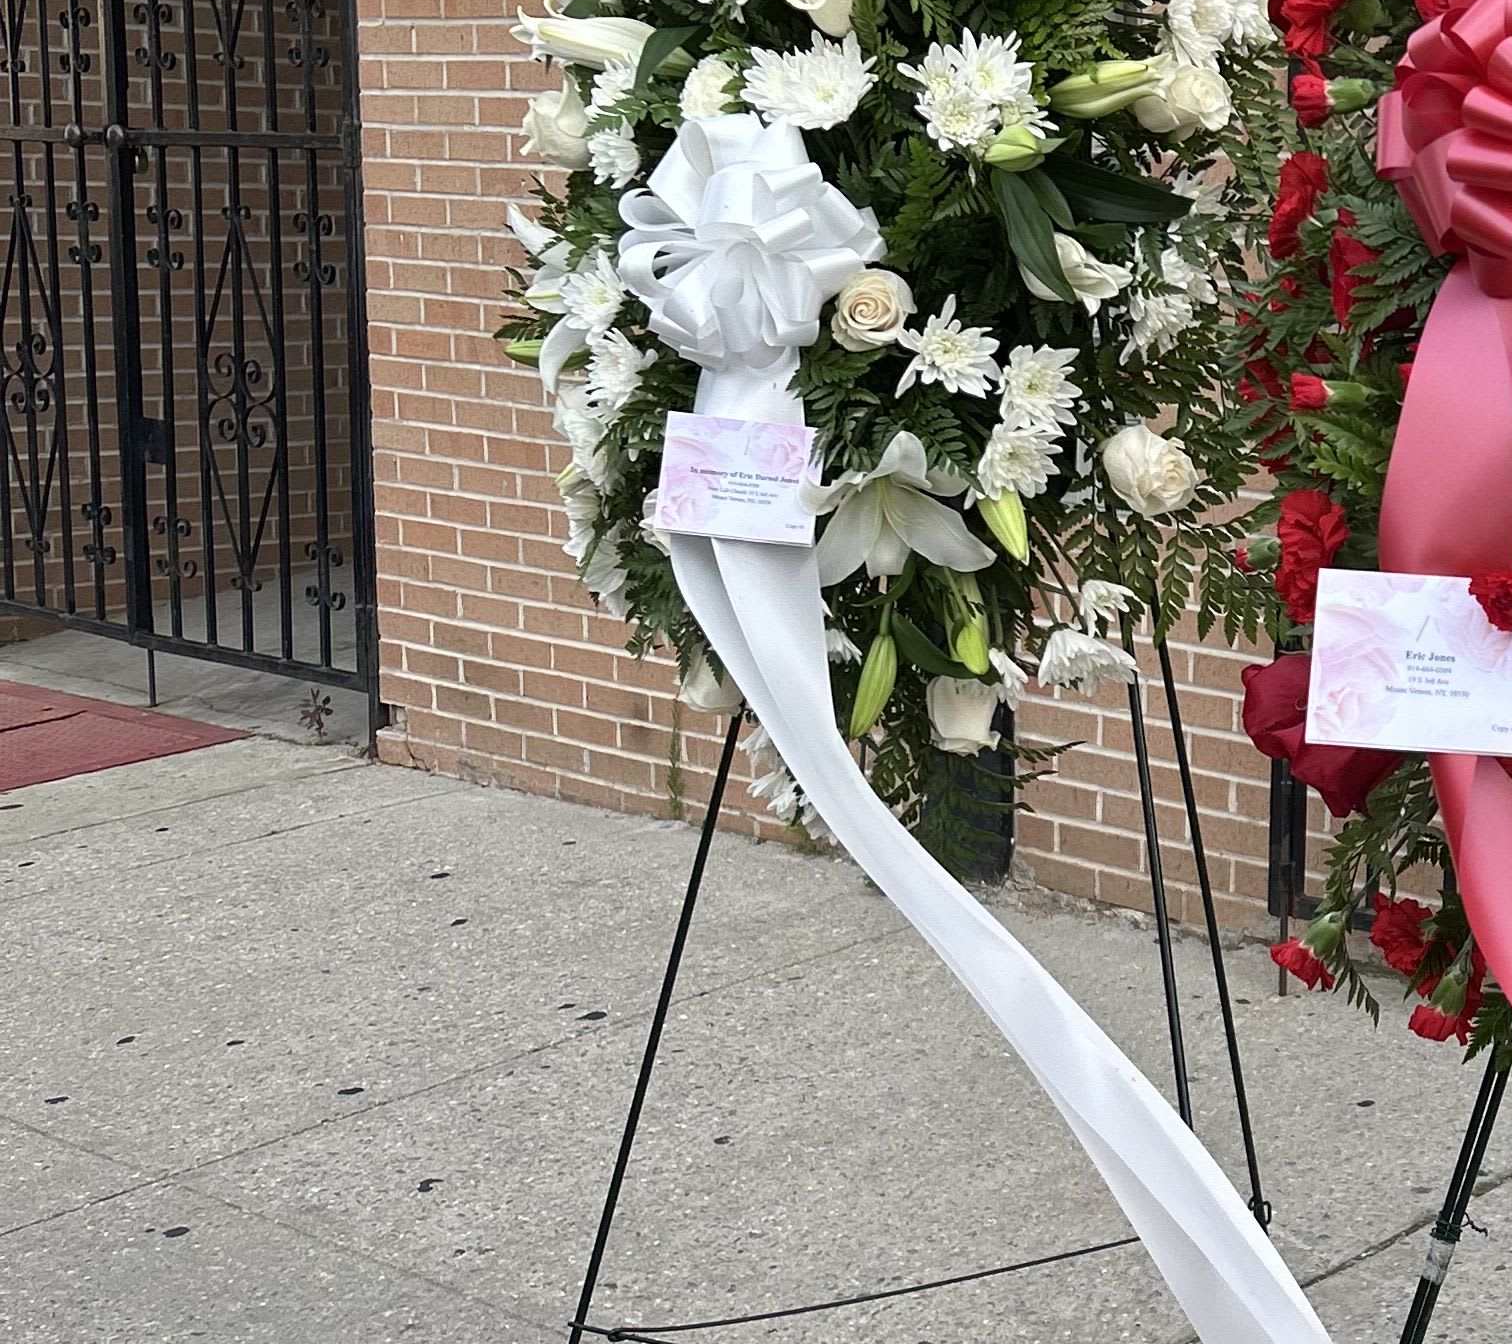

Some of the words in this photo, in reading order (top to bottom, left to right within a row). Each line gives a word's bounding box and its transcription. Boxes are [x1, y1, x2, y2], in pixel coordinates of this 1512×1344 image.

[739, 472, 753, 480] Eric
[1406, 650, 1426, 661] Eric
[1428, 652, 1456, 663] Jones
[1491, 724, 1509, 734] Copy
